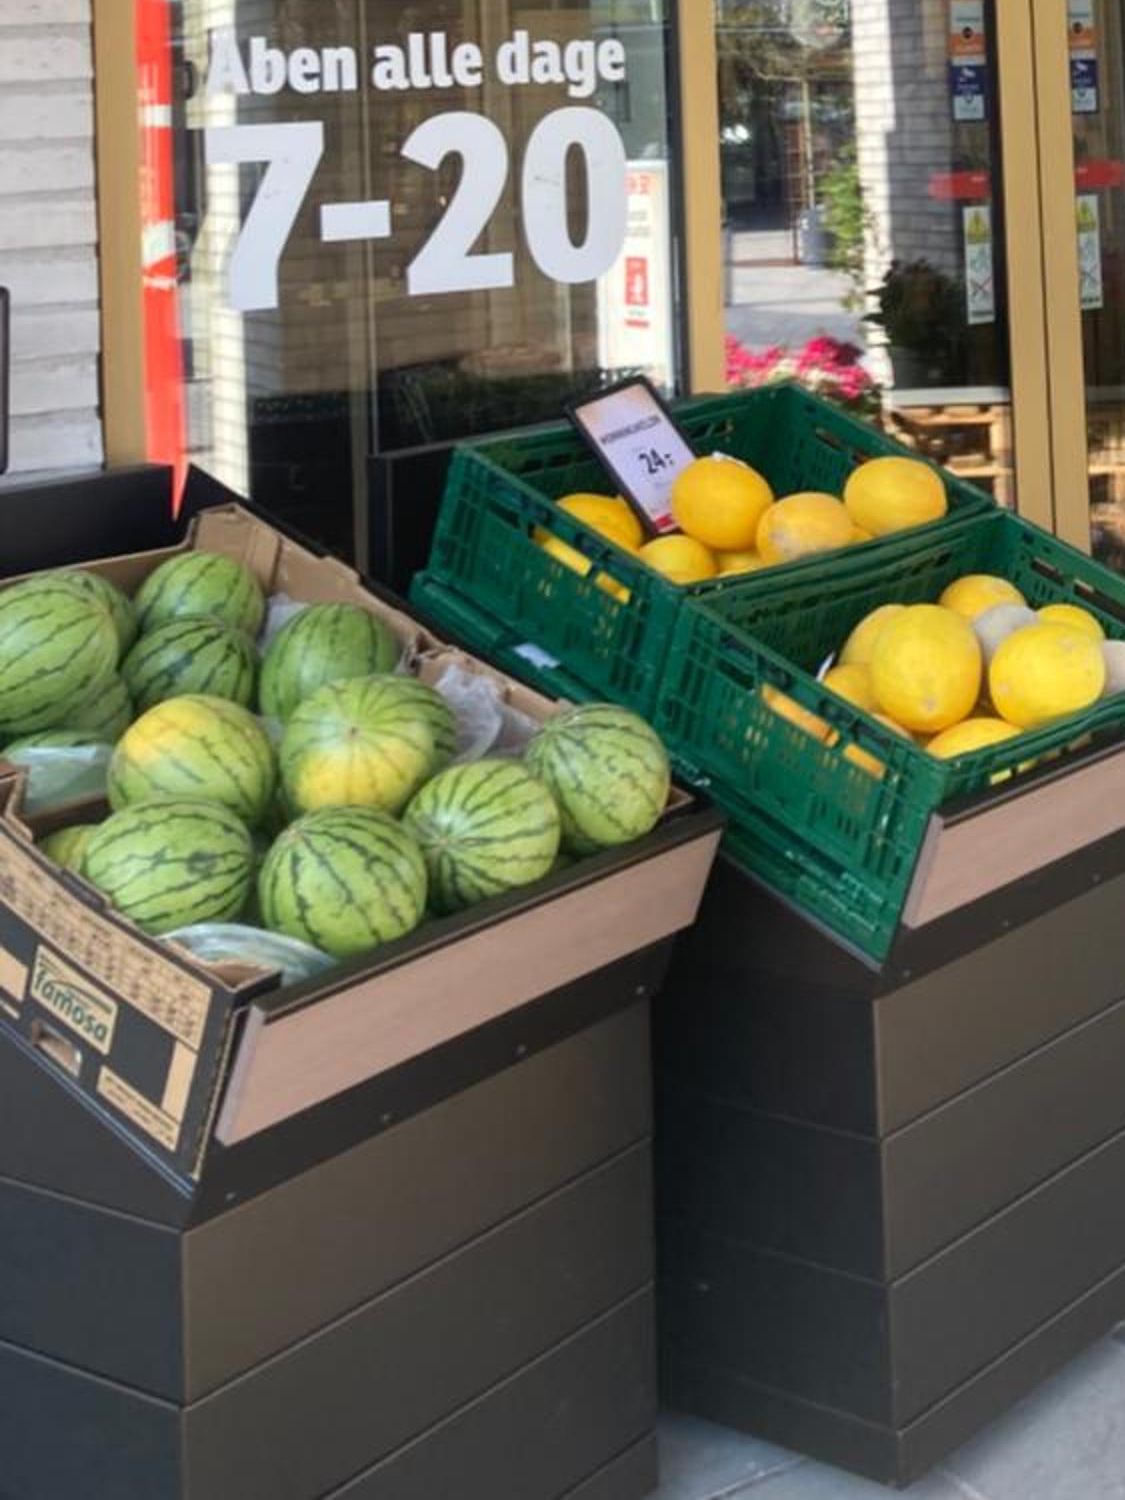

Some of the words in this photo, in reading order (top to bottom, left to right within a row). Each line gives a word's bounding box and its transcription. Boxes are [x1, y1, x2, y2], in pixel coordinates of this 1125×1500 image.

[372, 32, 482, 92] alle
[496, 30, 626, 97] dage
[204, 105, 629, 312] 7-20
